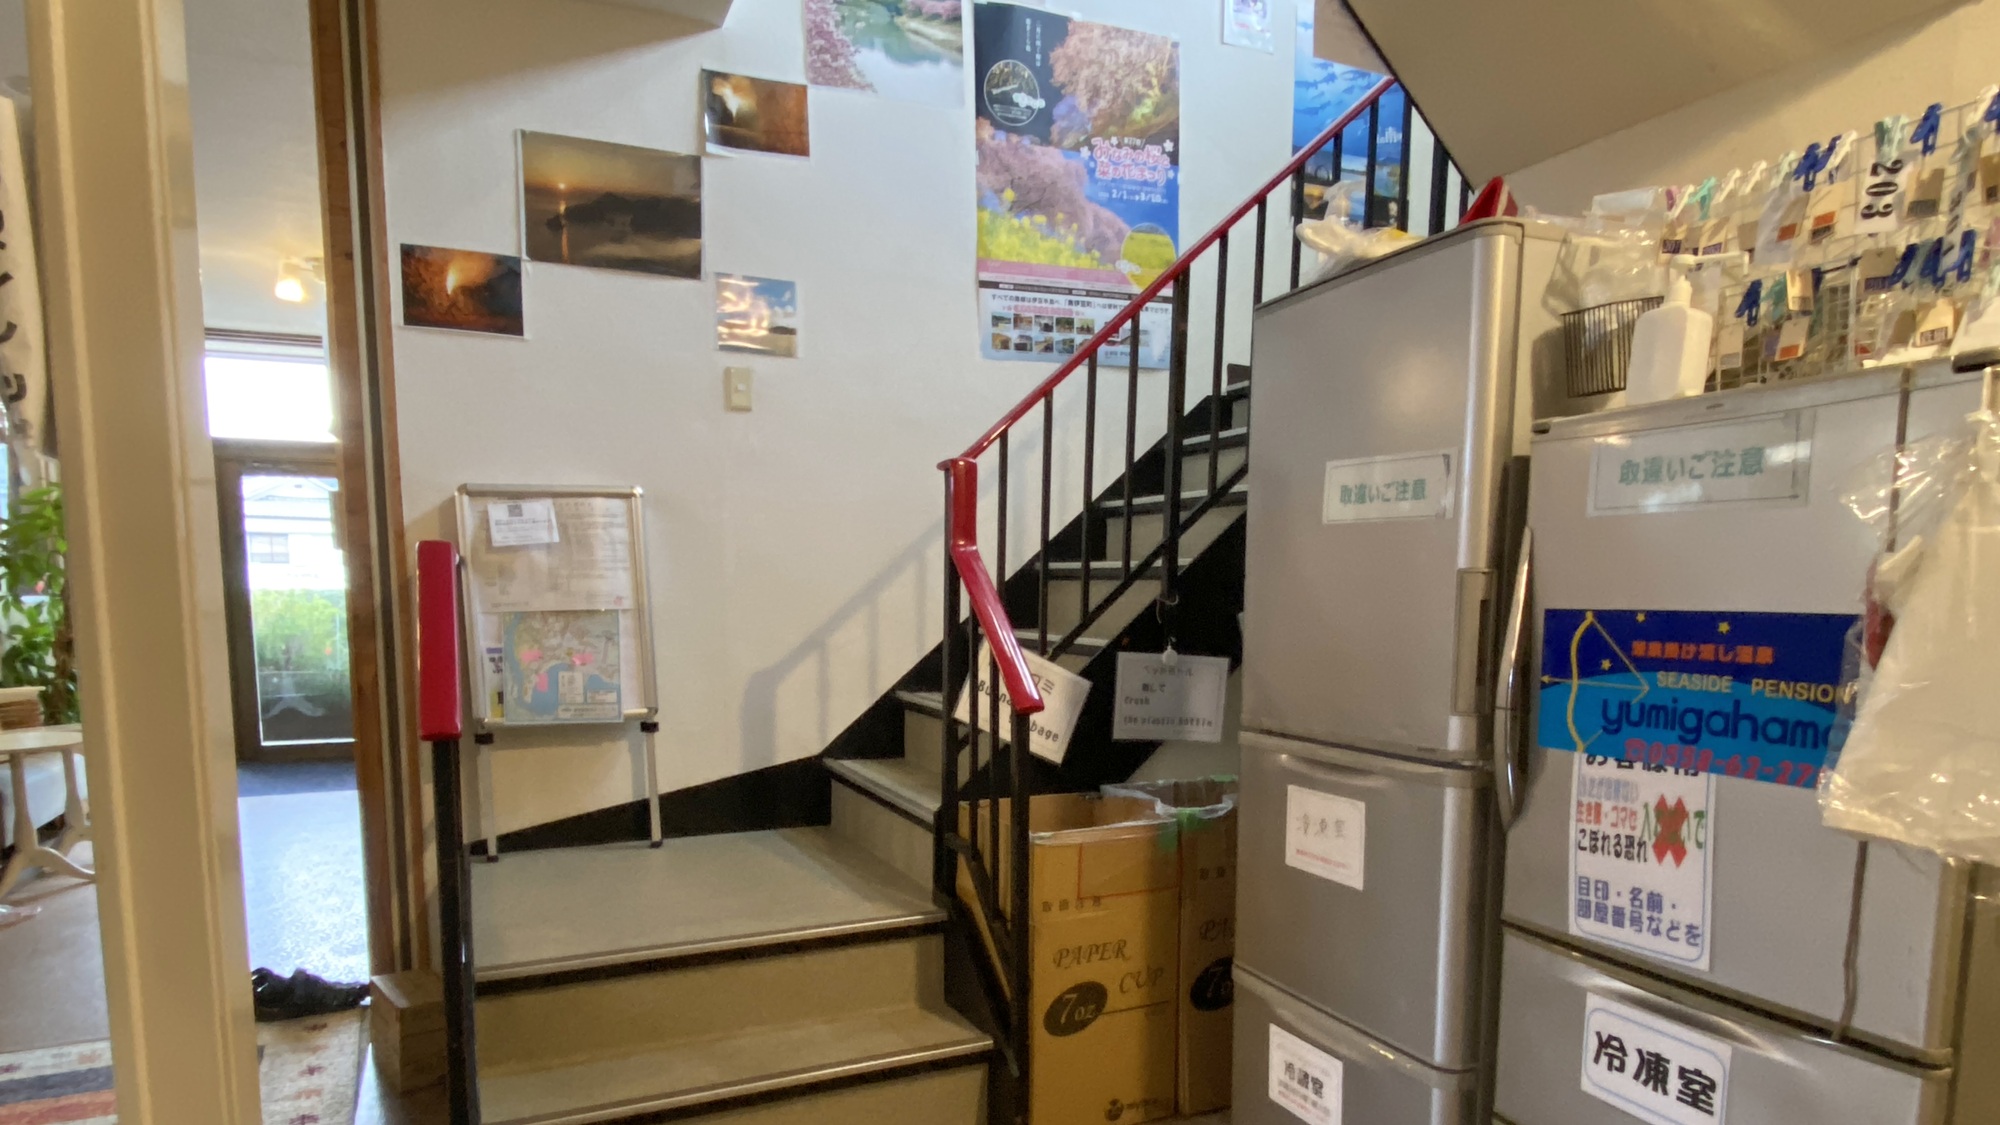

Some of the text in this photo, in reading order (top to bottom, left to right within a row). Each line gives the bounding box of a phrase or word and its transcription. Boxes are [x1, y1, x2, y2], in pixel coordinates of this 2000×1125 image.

[1090, 136, 1170, 169] みなみの桜と
[1095, 161, 1167, 188] 菜の花まつり
[1860, 159, 1904, 220] 203
[1656, 671, 1734, 694] SEASIDE
[1577, 828, 1648, 863] こぼれる恐れ
[1577, 898, 1702, 947] 部屋番号などを
[1053, 939, 1130, 969] PAPER
[1119, 966, 1165, 995] CUP
[1059, 993, 1079, 1025] 7
[1593, 1031, 1717, 1117] 冷凍室
